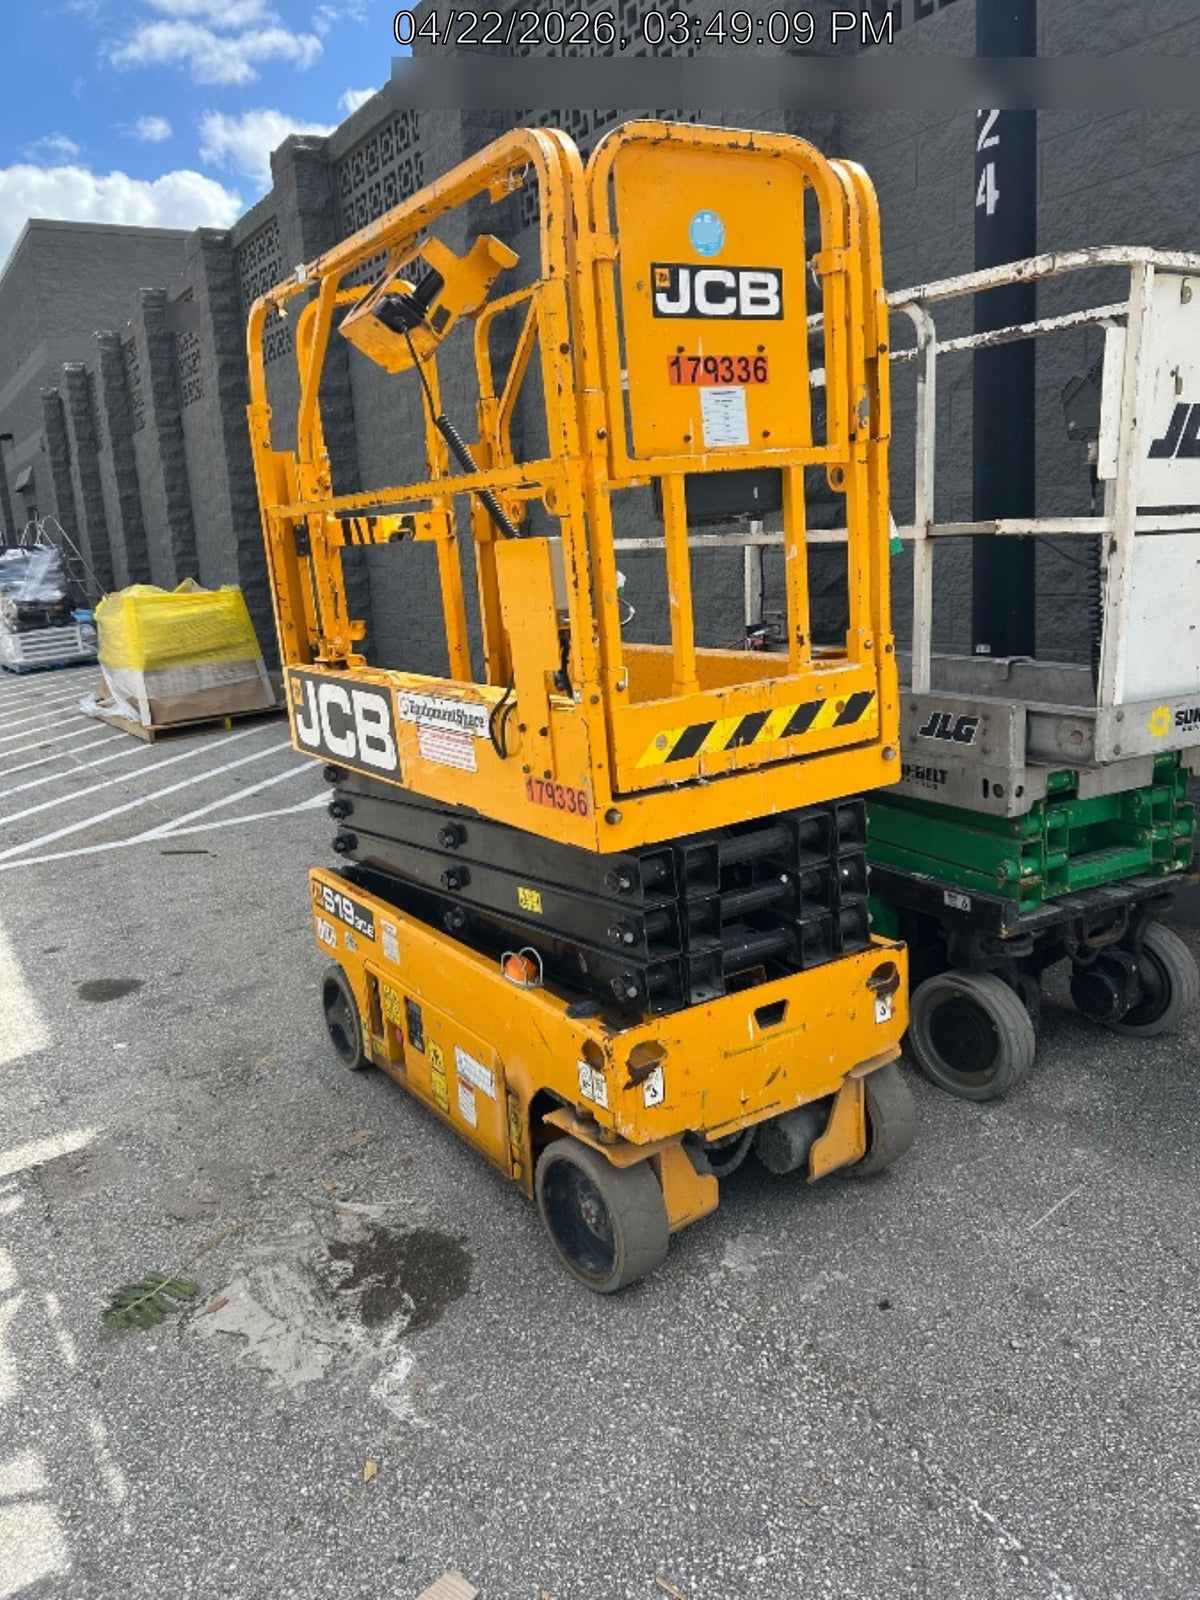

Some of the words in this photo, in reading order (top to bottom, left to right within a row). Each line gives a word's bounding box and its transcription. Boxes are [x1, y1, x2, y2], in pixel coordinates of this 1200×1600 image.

[655, 268, 780, 316] JCB
[670, 355, 768, 384] 179336
[295, 679, 398, 772] JCB
[918, 711, 981, 745] JLG
[526, 776, 588, 817] 179336
